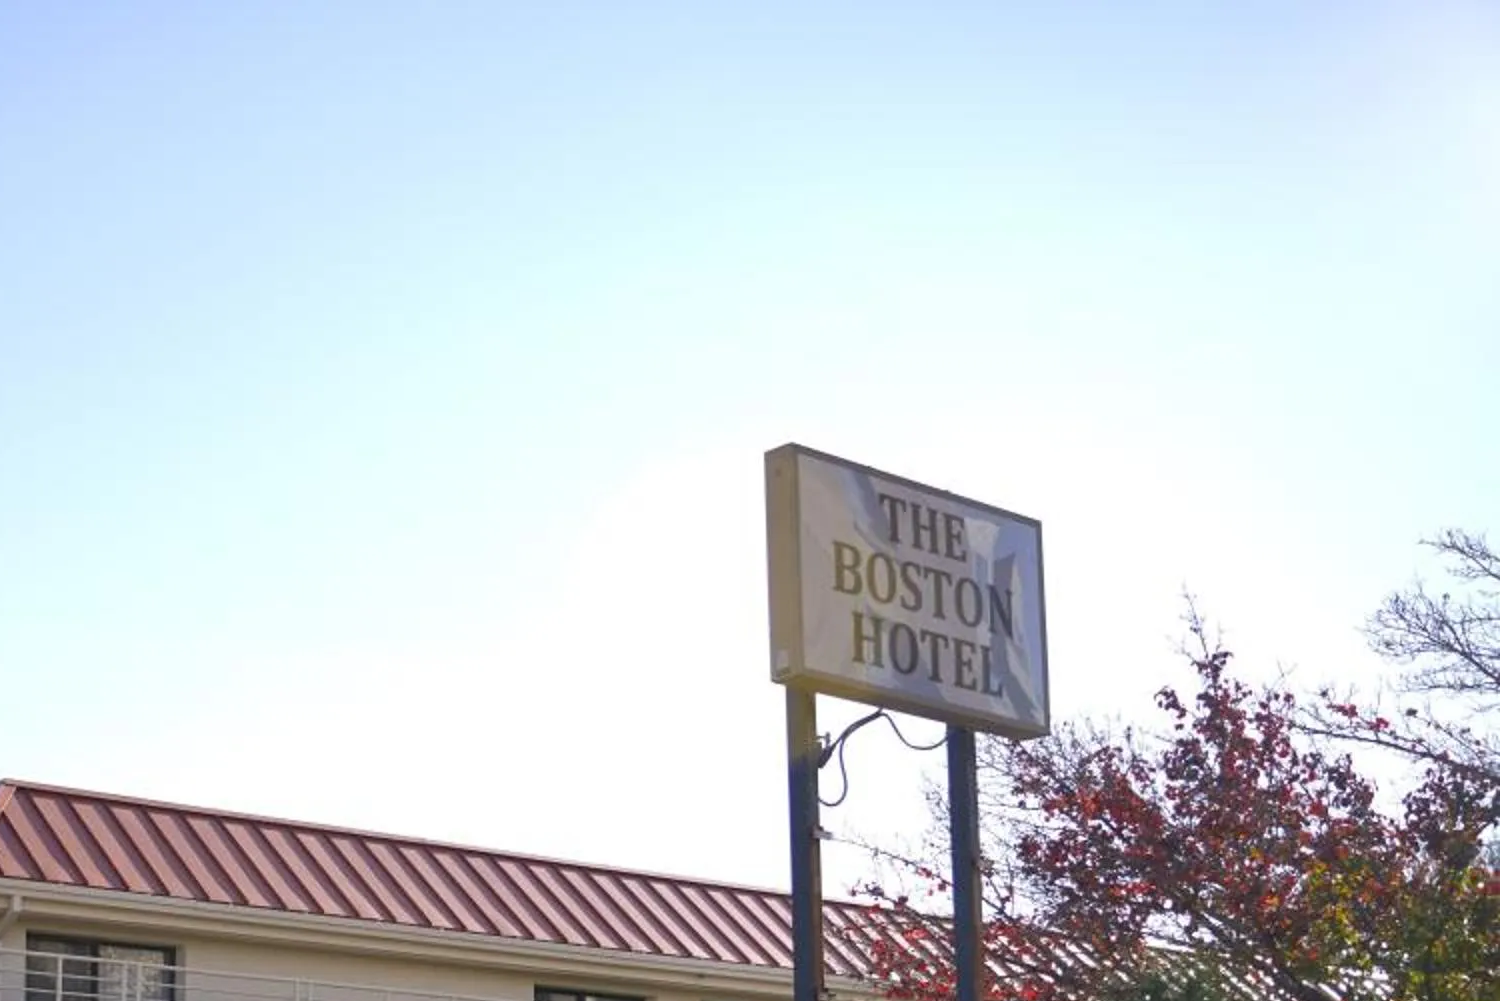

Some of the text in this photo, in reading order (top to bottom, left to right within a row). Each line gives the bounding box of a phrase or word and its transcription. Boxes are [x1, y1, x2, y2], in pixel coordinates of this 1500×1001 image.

[879, 494, 967, 562] THE
[832, 540, 1014, 640] BOSTON
[851, 611, 1004, 697] HOTEL
